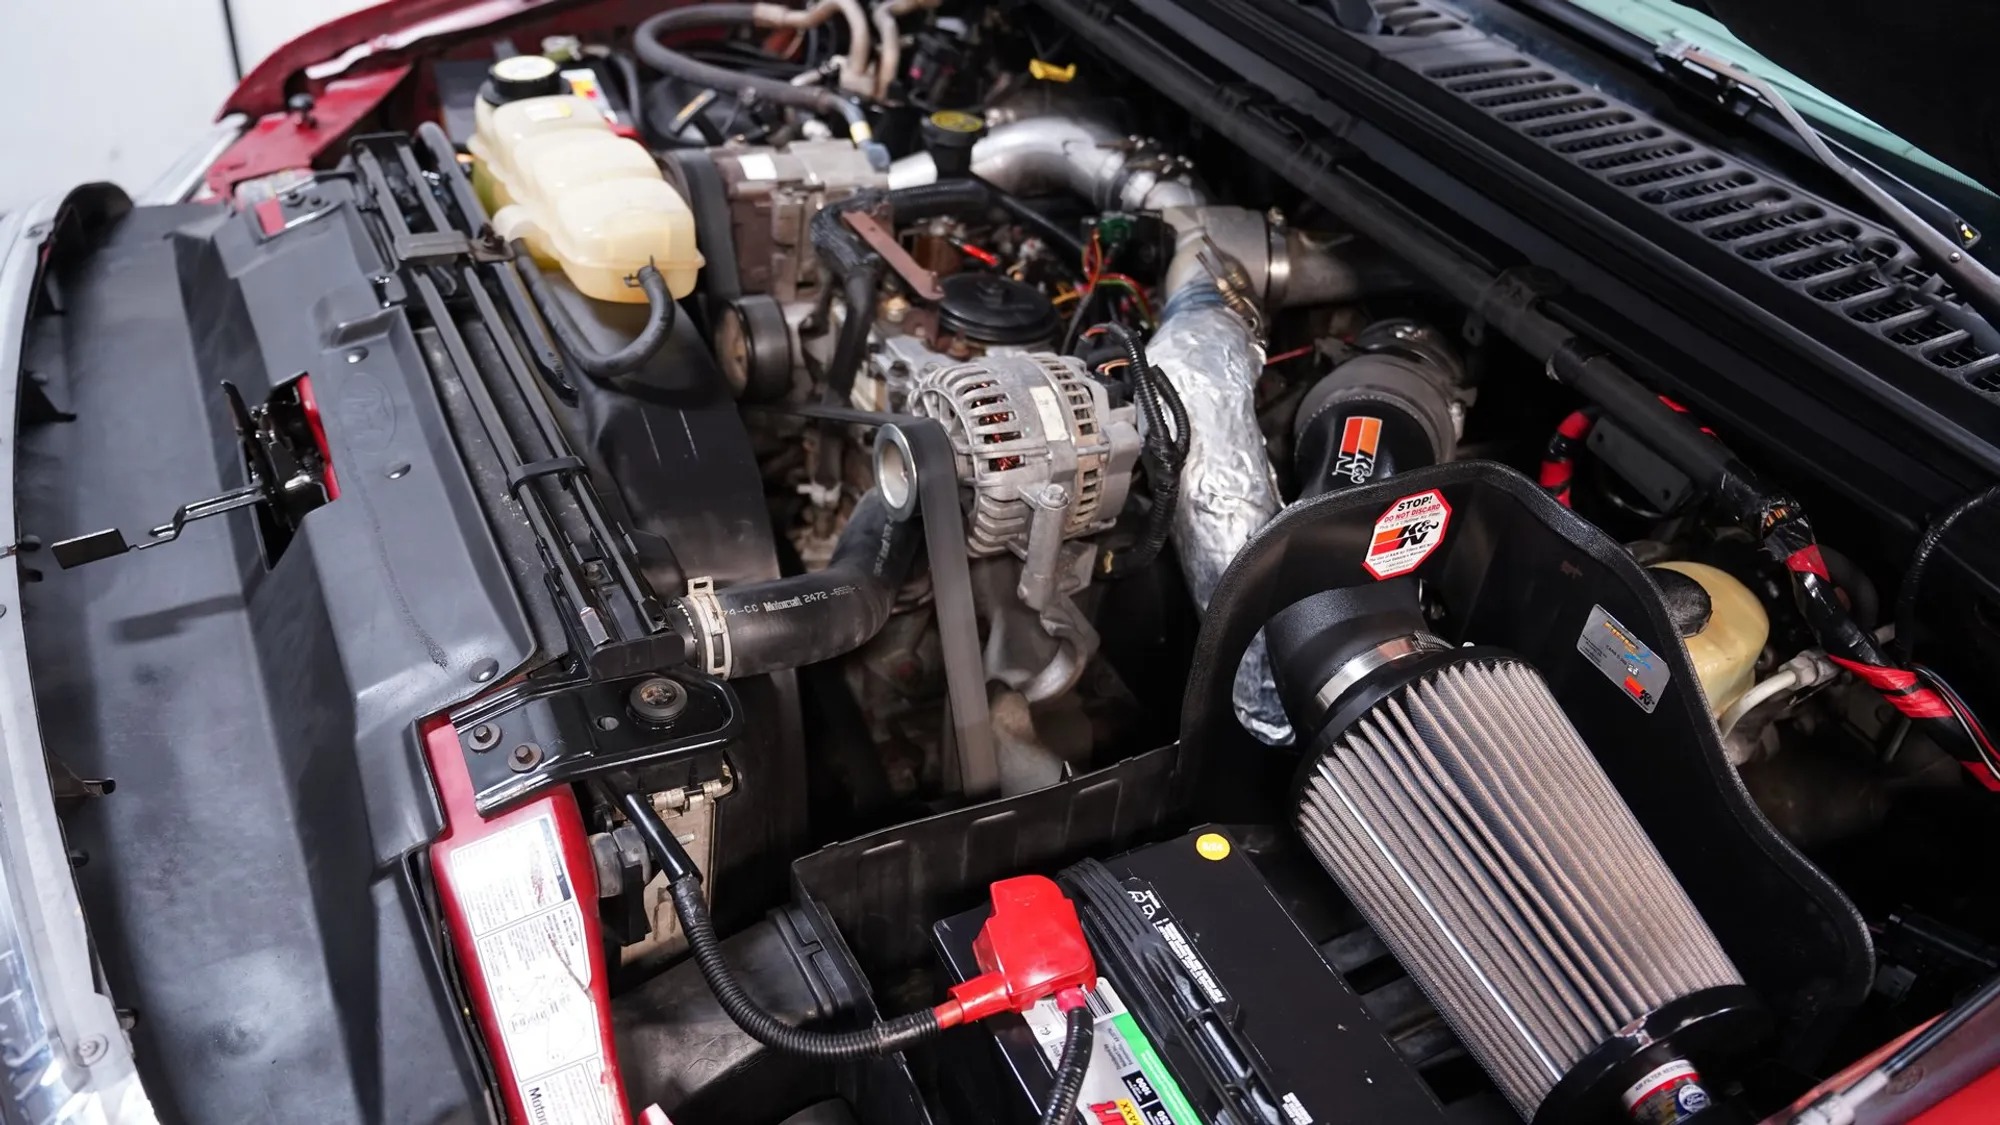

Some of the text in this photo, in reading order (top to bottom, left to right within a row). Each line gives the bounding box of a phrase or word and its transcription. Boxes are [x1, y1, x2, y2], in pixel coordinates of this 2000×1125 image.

[1398, 496, 1433, 511] STOP!
[1384, 504, 1441, 523] DO NOT DISCARD
[1396, 520, 1439, 549] K&N
[763, 596, 802, 612] Motorcraft
[802, 591, 828, 603] 2472
[1135, 1077, 1152, 1096] 1000
